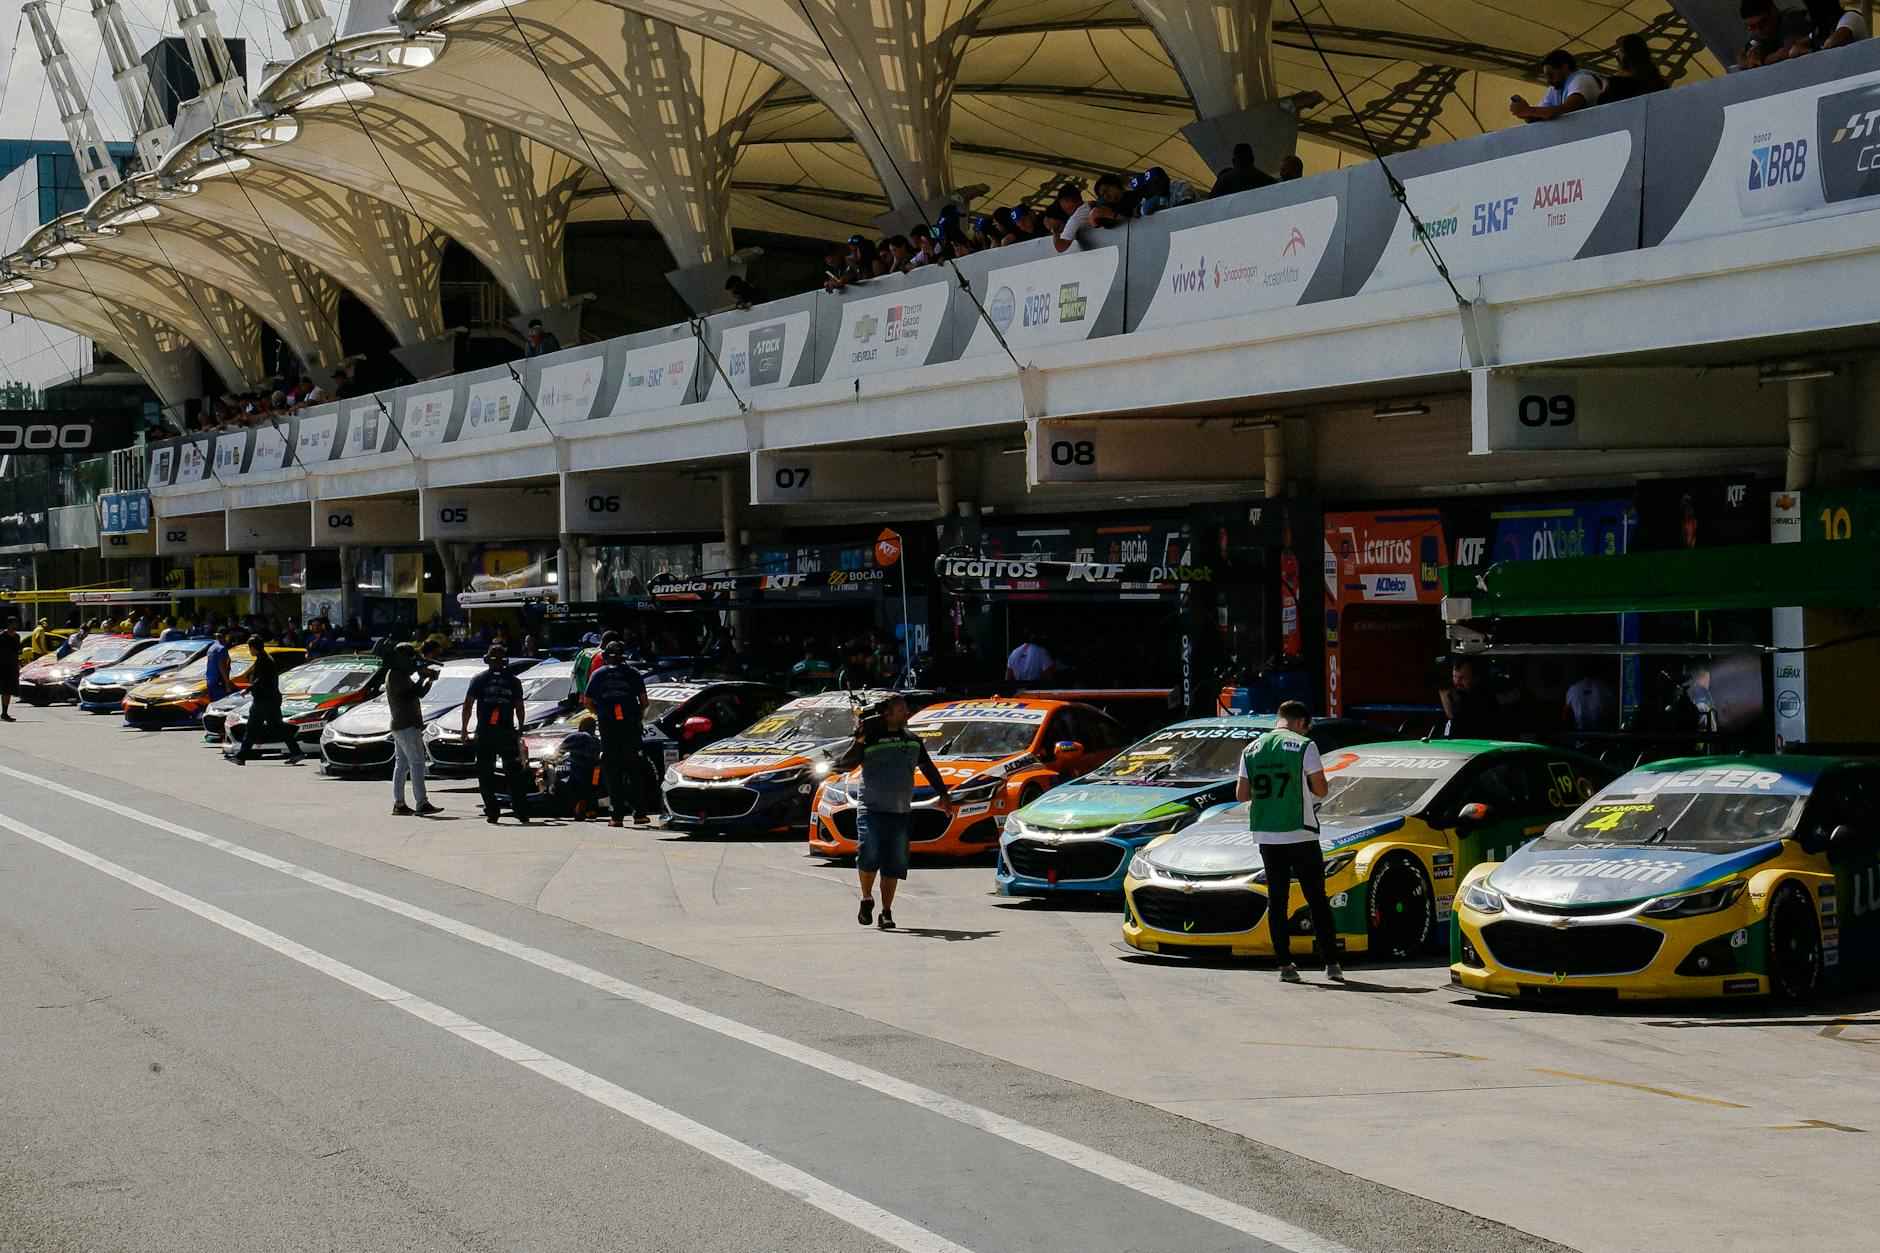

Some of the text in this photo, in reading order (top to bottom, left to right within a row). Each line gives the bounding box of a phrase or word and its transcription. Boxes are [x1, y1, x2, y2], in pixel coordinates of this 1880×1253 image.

[1767, 139, 1808, 187] BRB
[1532, 178, 1583, 210] AXALTA
[1472, 196, 1519, 237] SKF
[1547, 211, 1567, 227] Tintas
[1172, 263, 1196, 294] vivo
[1031, 292, 1051, 326] BRB
[1518, 395, 1575, 427] 09
[1051, 441, 1095, 465] 08
[776, 468, 810, 489] 07
[588, 495, 620, 513] 06
[1727, 484, 1747, 508] KTF
[328, 513, 354, 529] 04
[440, 507, 468, 524] 05
[1820, 506, 1854, 541] 10
[166, 530, 187, 542] 02
[1363, 529, 1412, 565] icarros
[1455, 537, 1486, 567] KTF
[944, 559, 1040, 579] icarros
[1253, 772, 1290, 800] 97
[1557, 774, 1573, 794] 19
[1583, 811, 1625, 833] 4
